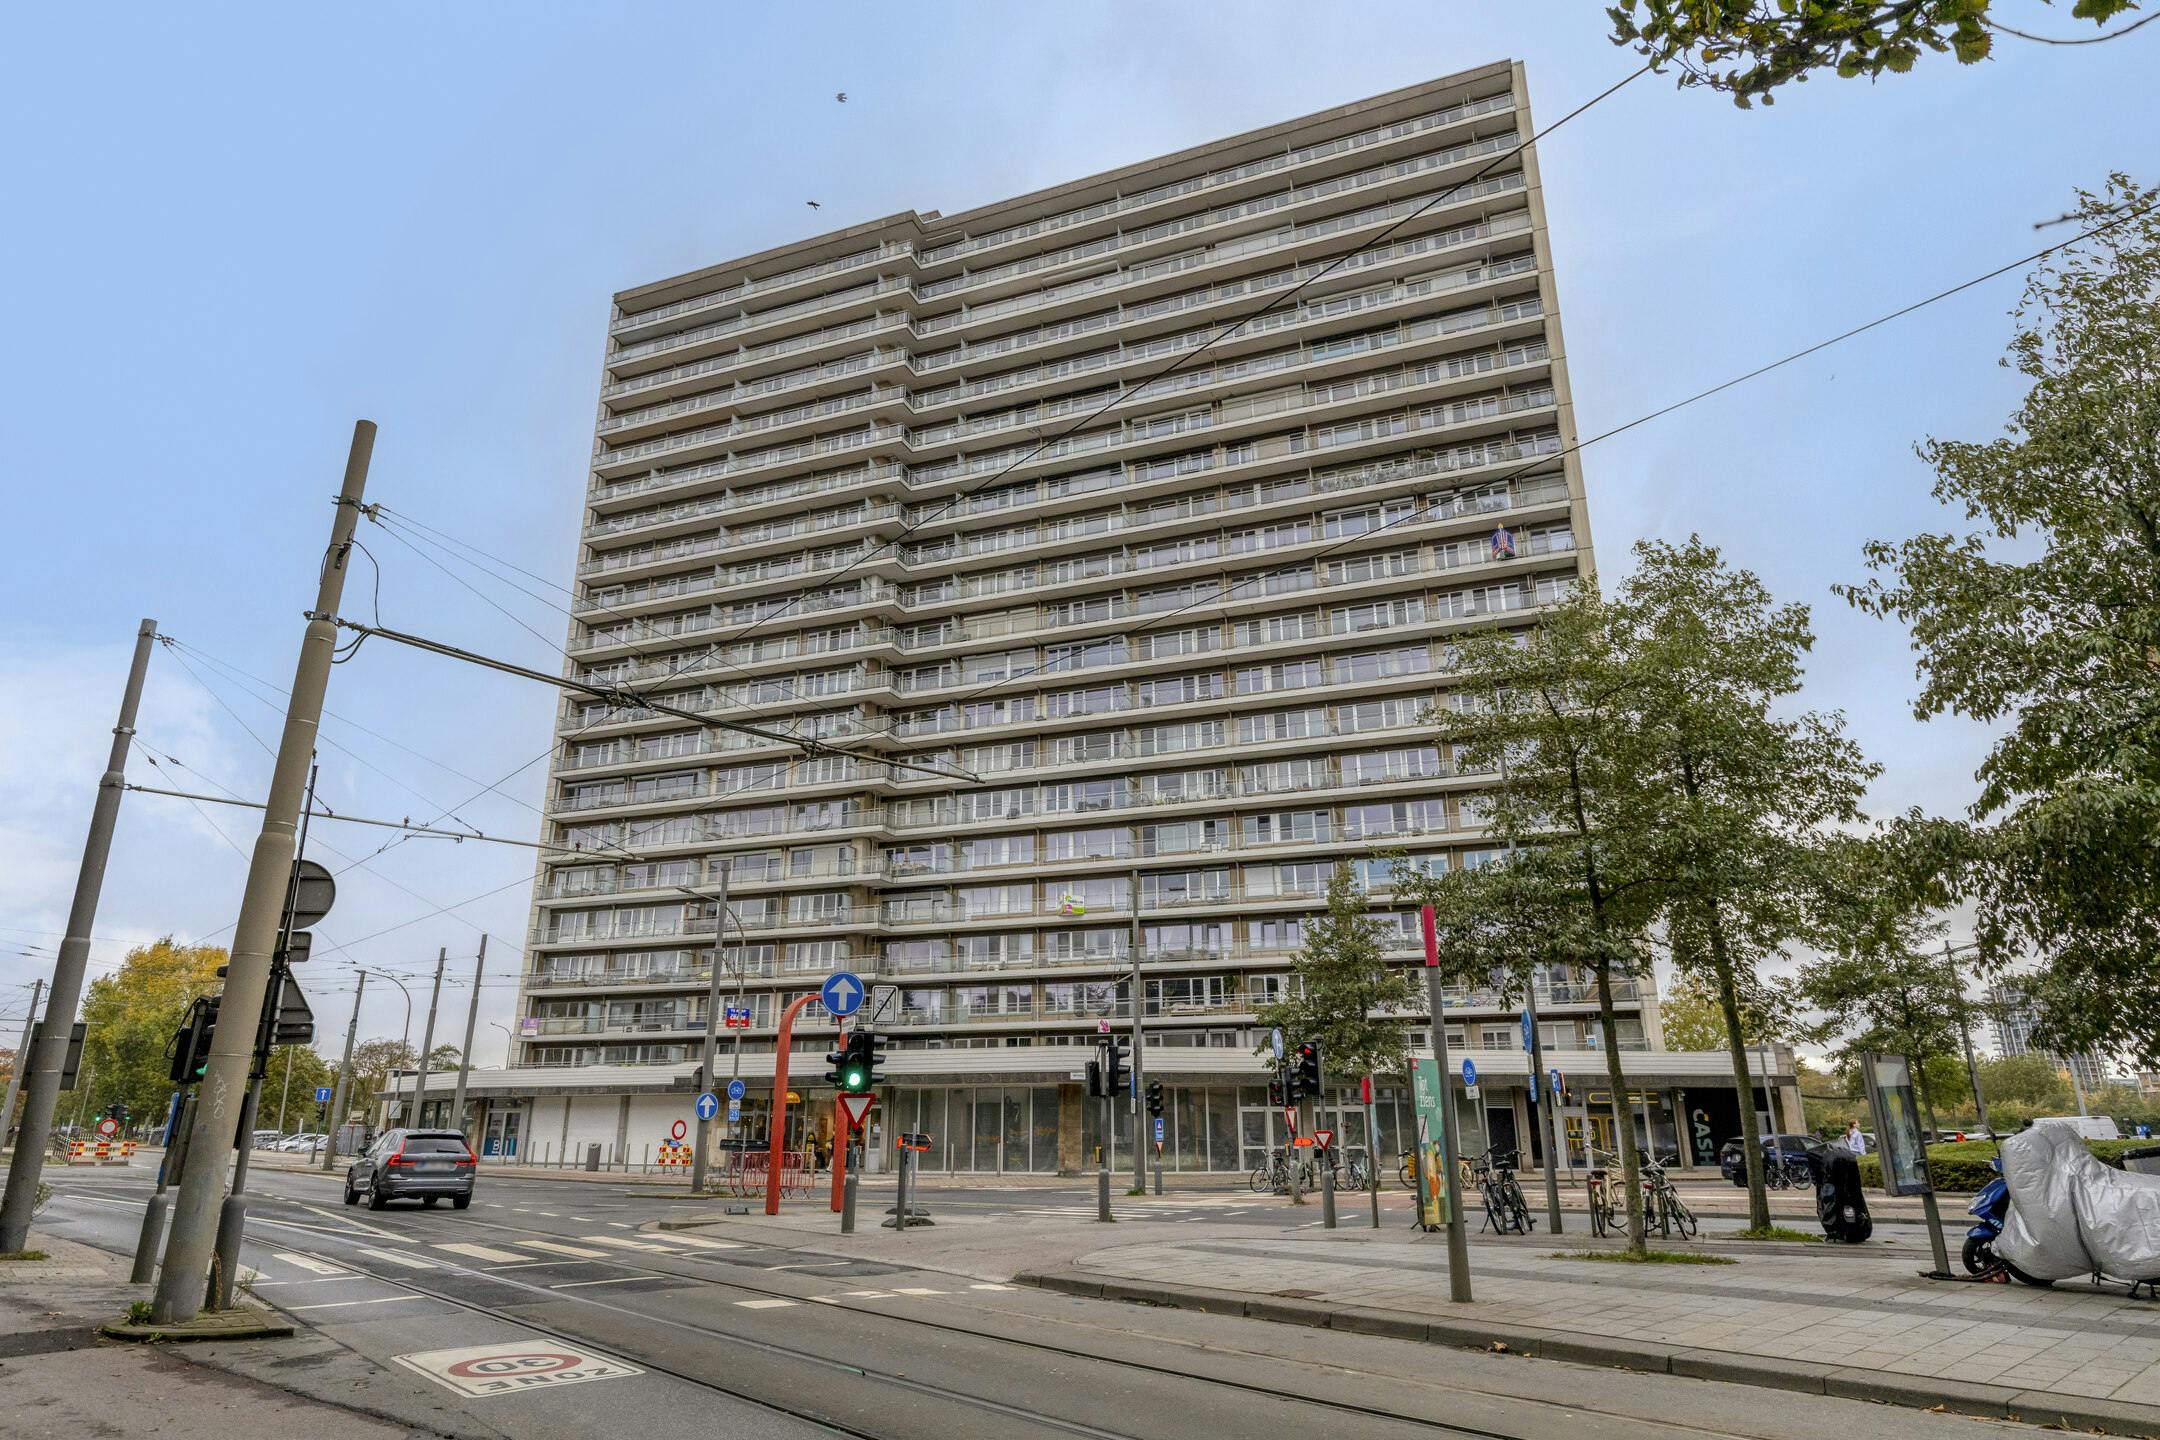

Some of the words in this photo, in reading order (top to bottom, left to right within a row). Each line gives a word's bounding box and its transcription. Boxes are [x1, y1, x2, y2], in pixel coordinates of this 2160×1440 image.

[877, 999, 892, 1010] 30
[1693, 1109, 1714, 1165] CASH
[475, 1357, 557, 1373] 30
[477, 1367, 617, 1391] ZONE
